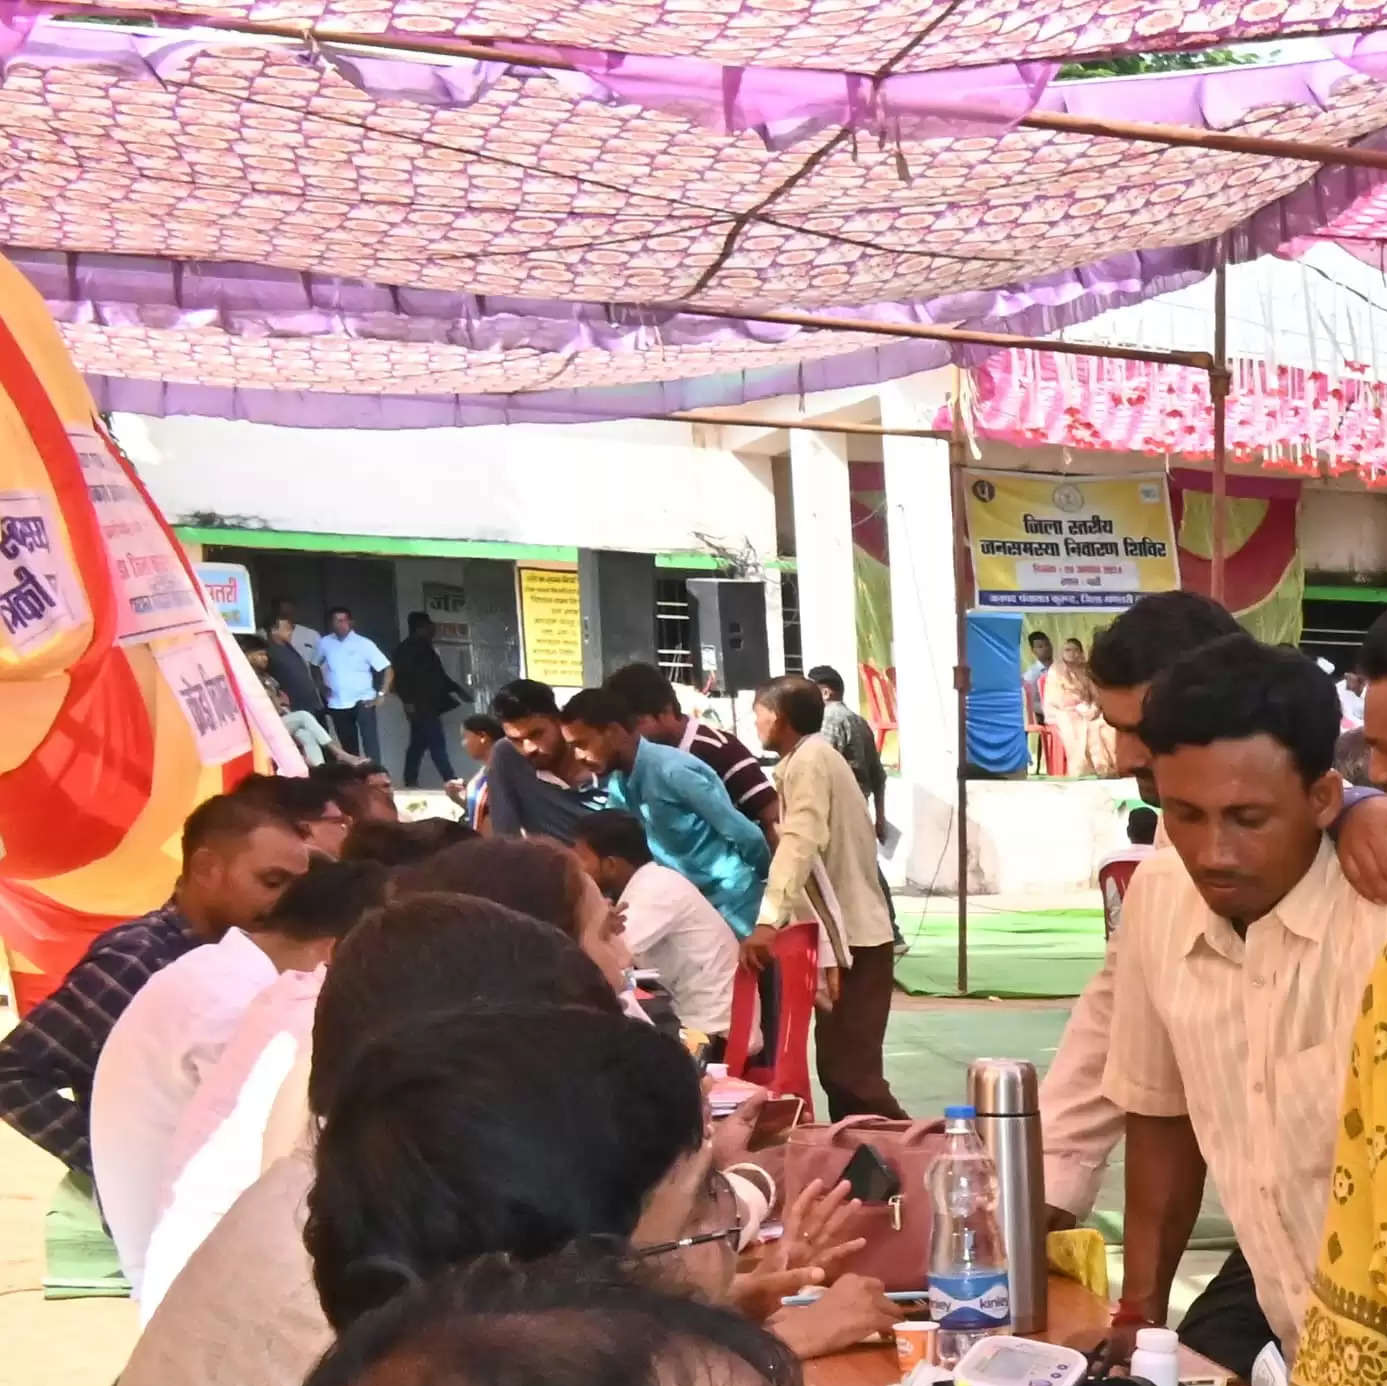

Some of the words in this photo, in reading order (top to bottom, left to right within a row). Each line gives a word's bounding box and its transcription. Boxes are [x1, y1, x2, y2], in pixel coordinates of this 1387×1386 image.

[1023, 514, 1063, 535] जिला
[1067, 514, 1113, 536] स्तरीय
[980, 539, 1060, 556] जनसमस्या
[1064, 536, 1119, 556] निवारण
[1123, 536, 1166, 556] शिविर
